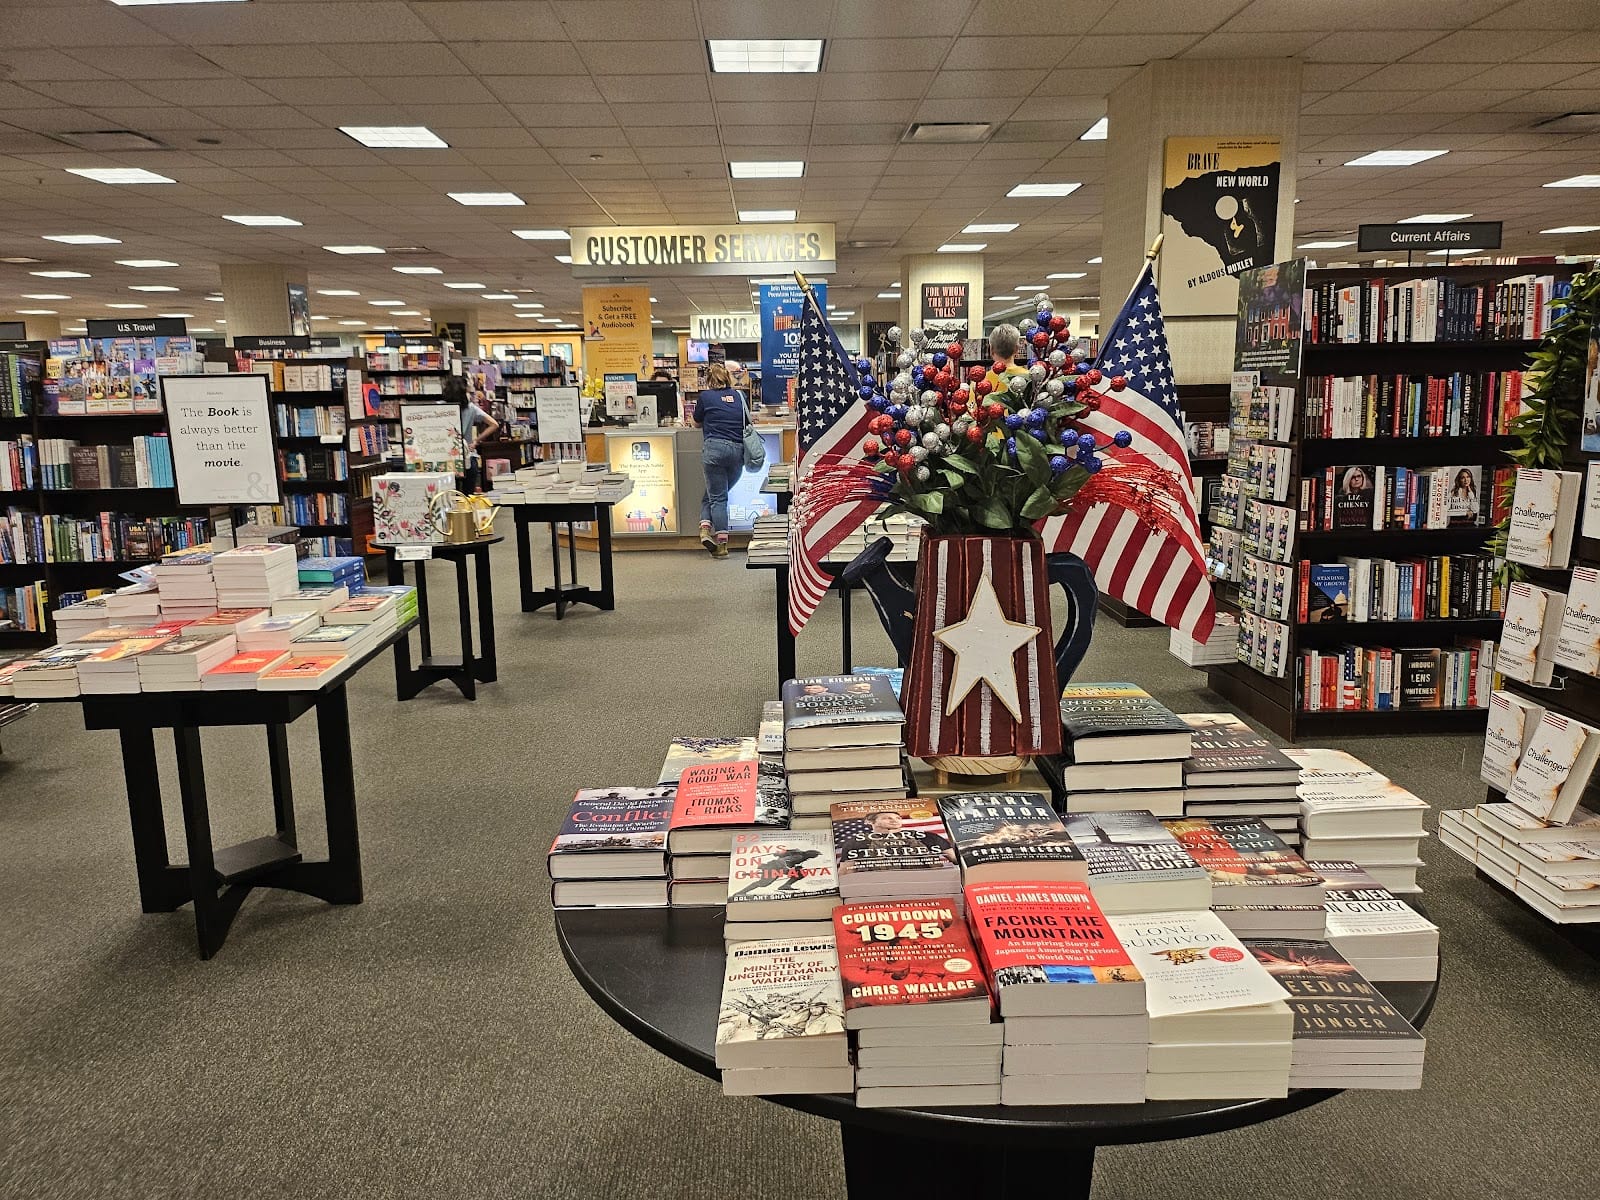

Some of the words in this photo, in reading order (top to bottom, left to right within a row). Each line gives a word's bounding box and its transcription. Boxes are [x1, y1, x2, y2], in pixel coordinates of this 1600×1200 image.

[1187, 153, 1220, 170] BRAVE
[1216, 176, 1236, 188] NEW
[1238, 176, 1269, 187] WORLD
[1390, 232, 1431, 243] Current
[1434, 230, 1470, 242] Affairs
[586, 235, 708, 265] CUSTOMER
[714, 232, 821, 263] SERVICES
[1188, 278, 1196, 288] BY
[1198, 268, 1226, 285] ALDOUS
[1226, 257, 1254, 274] HUXLEY
[926, 286, 940, 296] FOR
[942, 286, 965, 296] WHOM
[928, 297, 942, 307] THE
[945, 297, 962, 306] BELL
[934, 308, 956, 318] TOLLS
[118, 324, 131, 332] U.S.
[133, 324, 156, 332] Travel
[699, 318, 748, 340] MUSIC
[751, 324, 759, 338] &
[935, 331, 958, 342] Ernest
[180, 408, 204, 418] The
[208, 407, 240, 416] Book
[242, 406, 252, 416] is
[180, 425, 220, 436] always
[224, 424, 258, 434] better
[196, 441, 224, 450] than
[227, 440, 246, 450] the
[204, 458, 244, 468] movie.
[1514, 506, 1551, 521] Challenger
[1566, 606, 1600, 624] Challenge
[1504, 618, 1538, 636] Challenger
[828, 676, 876, 684] KILMEADE
[1411, 674, 1430, 682] LENS
[1404, 687, 1436, 695] WHITENESS
[795, 700, 864, 708] BOOKER
[1191, 740, 1270, 748] NOLULU
[1488, 728, 1518, 749] Challenger
[1528, 748, 1568, 773] Challenger
[690, 766, 736, 776] WAGING
[687, 776, 718, 784] GOOD
[726, 772, 751, 780] WAR
[692, 796, 740, 806] THOMAS
[870, 802, 927, 810] KENNEDY
[958, 796, 1032, 808] PEARL
[572, 810, 673, 822] Conflict
[686, 807, 696, 816] E.
[704, 804, 742, 814] RICKS
[954, 807, 1049, 820] HARBOR
[1166, 822, 1262, 832] MIDNIGHT
[736, 834, 760, 842] 82
[856, 830, 926, 842] SCARS
[1200, 832, 1260, 840] BROAD
[736, 844, 788, 854] DAYS
[1126, 844, 1185, 854] BLIND
[1182, 840, 1275, 849] DAYLIGHT
[848, 845, 942, 860] STRIPES
[972, 846, 1012, 857] CRAIG
[1132, 852, 1190, 862] MAN'S
[736, 858, 762, 866] ON
[1138, 860, 1196, 870] BLUFF
[1308, 861, 1358, 870] akauer
[734, 867, 832, 880] OKINAWA
[976, 894, 1014, 904] DANIEL
[1016, 893, 1050, 903] JAMES
[1050, 893, 1090, 903] BROWN
[1352, 889, 1395, 900] MEN
[1346, 902, 1406, 912] GLORY
[842, 908, 952, 925] COUNTDOWN
[984, 916, 1057, 928] FACING
[1060, 916, 1103, 926] THE
[856, 922, 942, 942] 1945
[994, 928, 1104, 940] MOUNTAIN
[1134, 924, 1194, 937] LONE
[1022, 940, 1065, 948] Inspiring
[1066, 940, 1088, 948] Story
[1120, 933, 1224, 948] SURVIVOR
[793, 944, 836, 952] Lewis
[744, 962, 804, 972] MINISTRY
[808, 960, 824, 968] OF
[728, 966, 838, 982] UNGENTLEMANLY
[752, 974, 814, 985] WARFARE
[851, 984, 900, 998] CHRIS
[904, 980, 976, 994] WALLACE
[1284, 980, 1374, 994] EEDOM
[1291, 1003, 1394, 1016] BASTIAN
[1302, 1017, 1388, 1029] JUNGER
